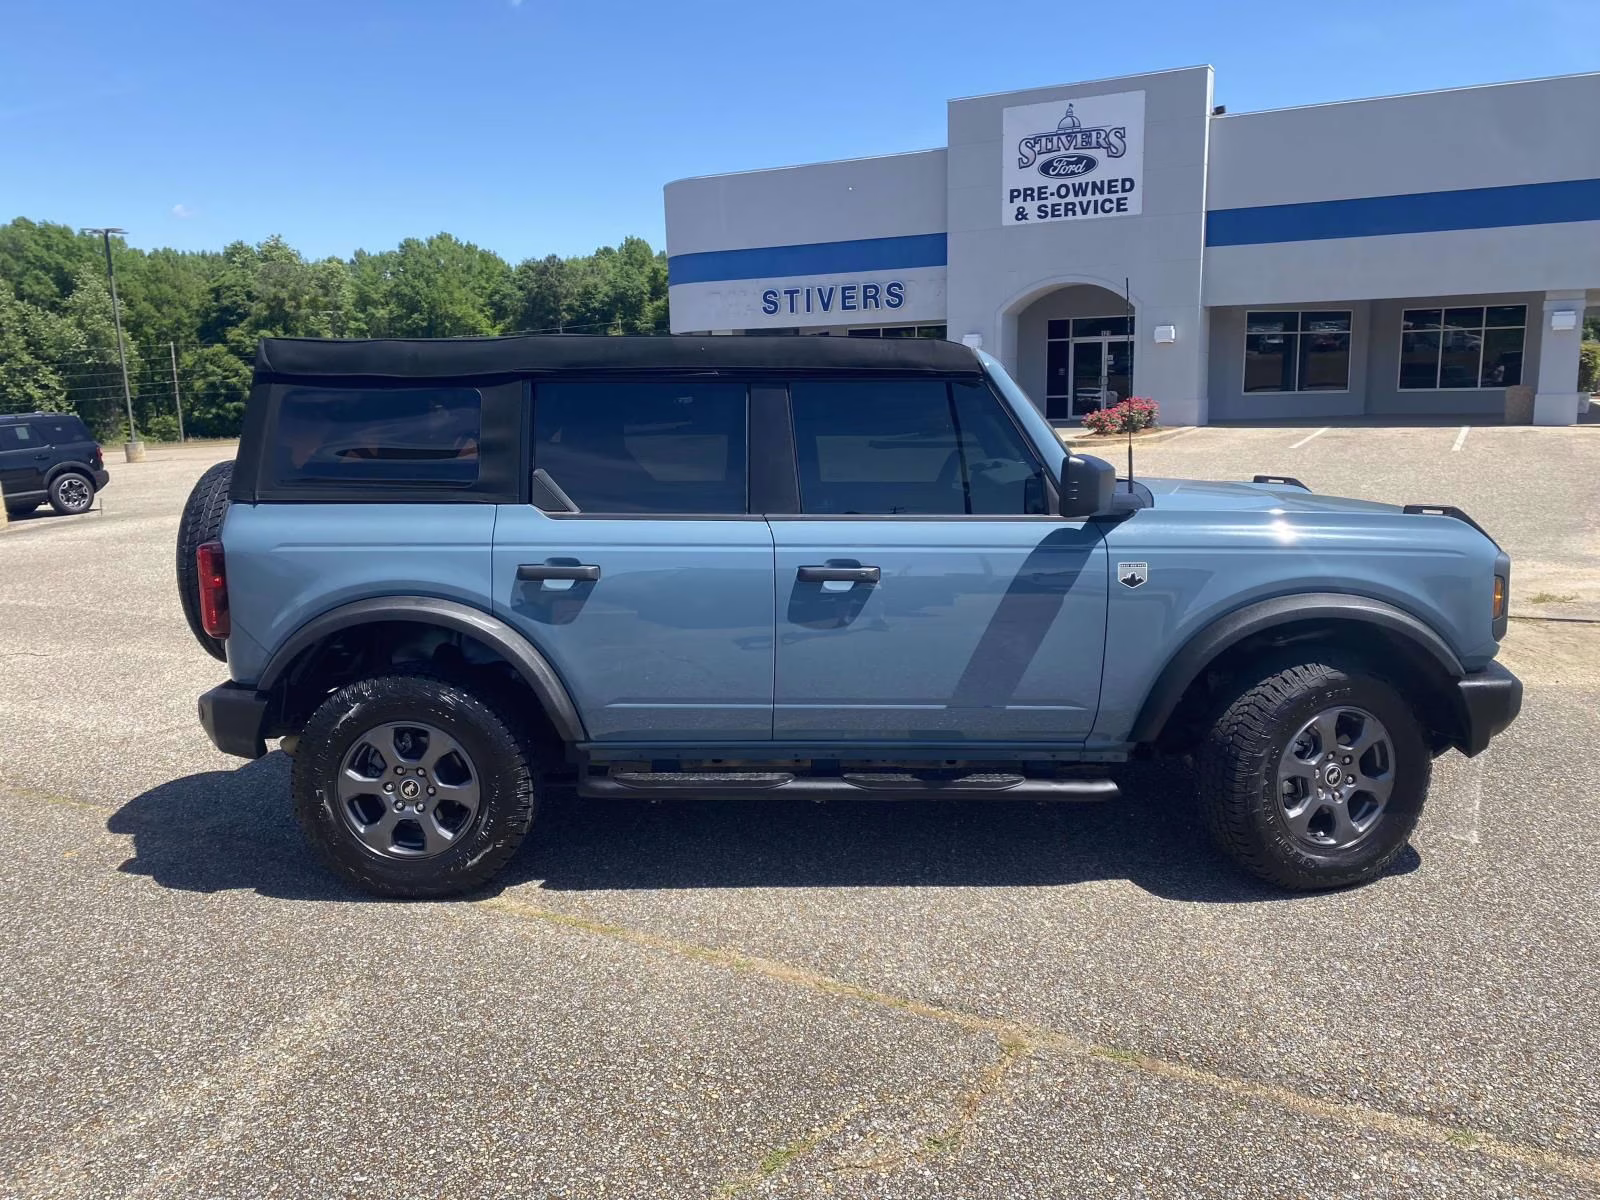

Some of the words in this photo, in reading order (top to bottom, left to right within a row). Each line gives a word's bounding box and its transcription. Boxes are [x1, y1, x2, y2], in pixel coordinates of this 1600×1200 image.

[1018, 126, 1127, 169] STIVERS
[1049, 156, 1088, 175] Ford
[1009, 177, 1136, 203] PRE-OWNED
[1014, 206, 1029, 221] &
[1036, 196, 1129, 219] SERVICE
[762, 281, 905, 315] STIVERS
